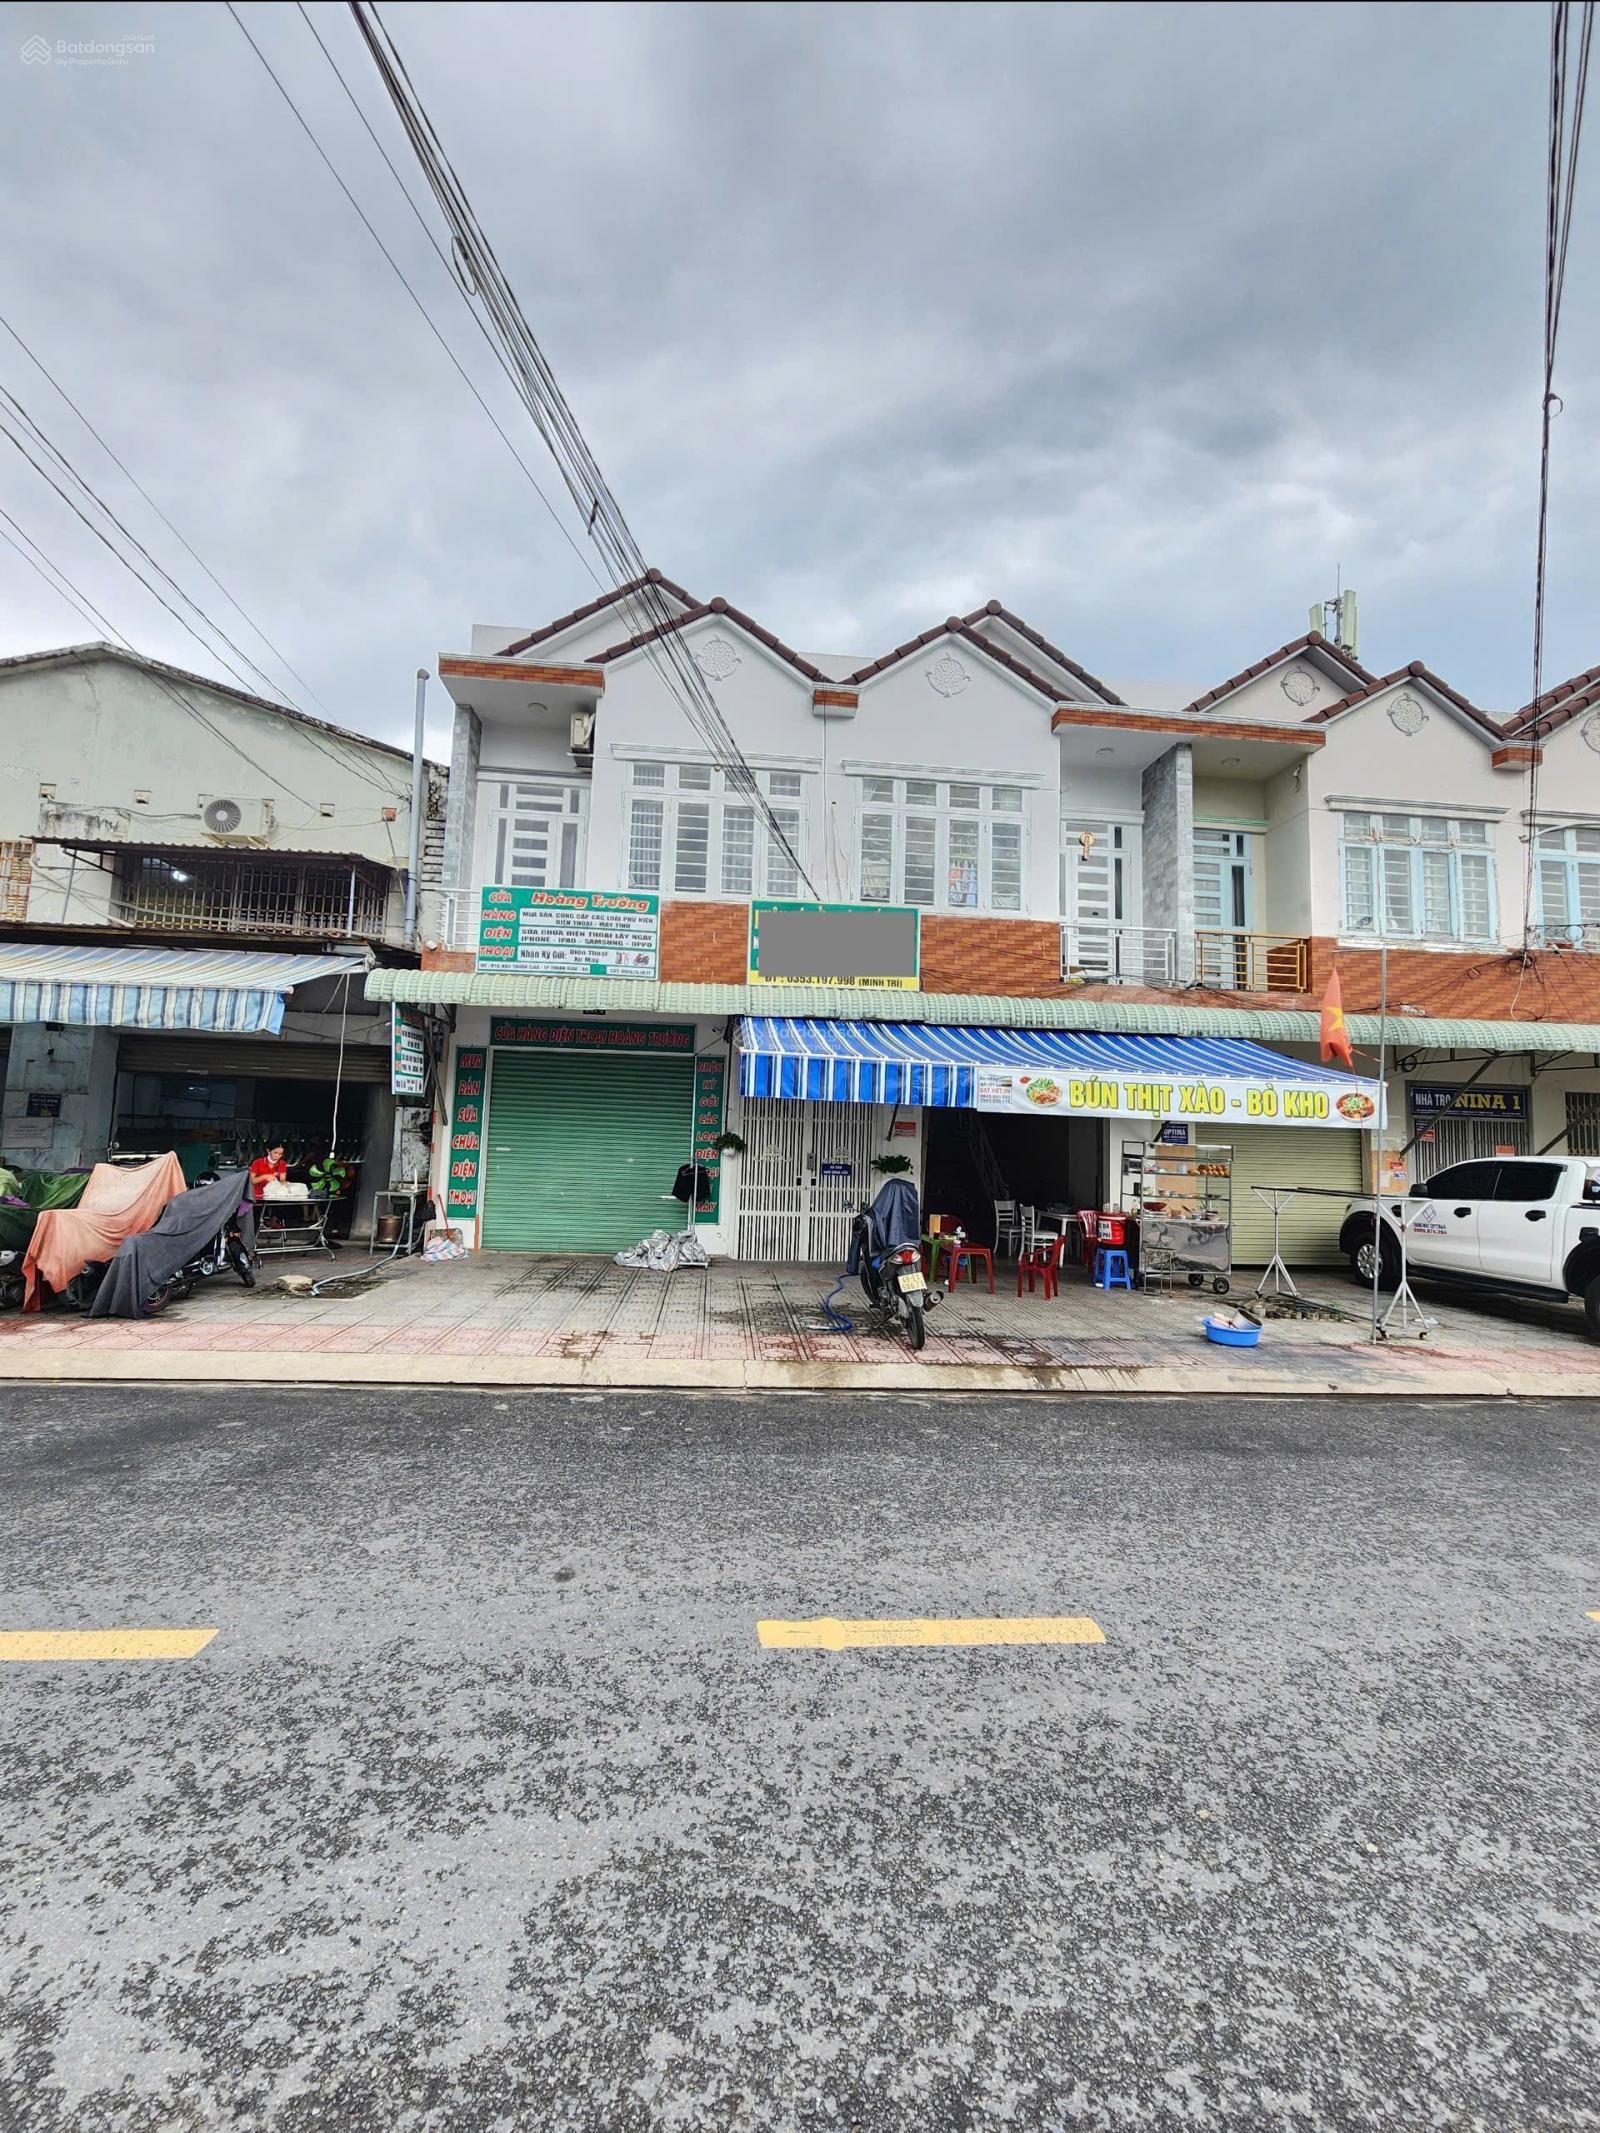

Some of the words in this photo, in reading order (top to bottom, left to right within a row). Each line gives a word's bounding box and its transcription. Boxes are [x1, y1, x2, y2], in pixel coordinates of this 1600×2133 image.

[482, 908, 517, 921] HÀNG
[484, 927, 513, 942] ĐIỆN
[584, 938, 624, 946] SAMSUNG
[858, 978, 885, 987] (MINH
[518, 1023, 547, 1042] HÀNG
[460, 1054, 482, 1068] MUA
[458, 1076, 480, 1095] BÁN
[1069, 1075, 1118, 1110] BÚN
[1123, 1082, 1173, 1118] THỊT
[1178, 1080, 1226, 1114] XÀO
[1246, 1083, 1278, 1116] BÒ
[1283, 1089, 1329, 1119] KHO
[1415, 1091, 1433, 1106] NHÀ
[1455, 1094, 1506, 1109] NINA
[1512, 1096, 1521, 1110] 1
[698, 1111, 718, 1125] CÁC
[1163, 1128, 1186, 1136] OPTIMA
[695, 1147, 719, 1162] ĐIỆN
[452, 1159, 476, 1182] ĐIỆN
[449, 1189, 475, 1209] THOẠI
